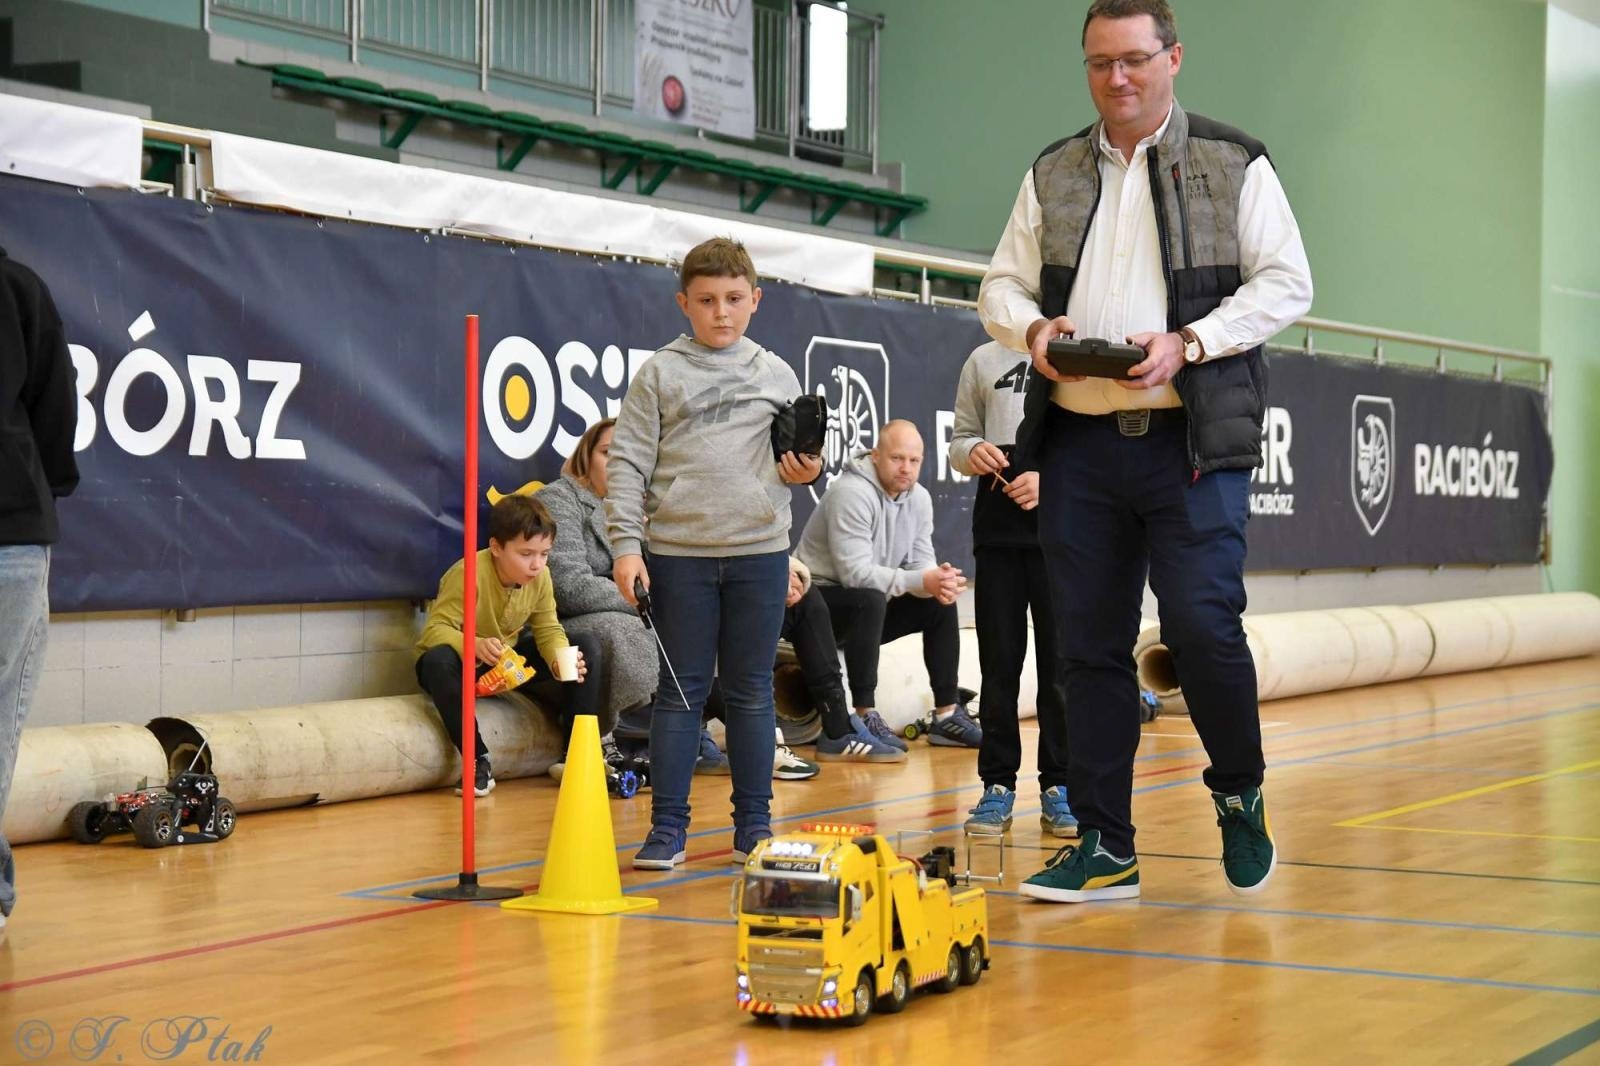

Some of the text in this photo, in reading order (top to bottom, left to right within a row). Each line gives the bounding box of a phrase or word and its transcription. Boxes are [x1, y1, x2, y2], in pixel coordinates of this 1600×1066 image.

[482, 335, 655, 461] OSi
[1415, 430, 1519, 499] RACIBÓRZ
[1248, 487, 1294, 516] ACIBÓRZ
